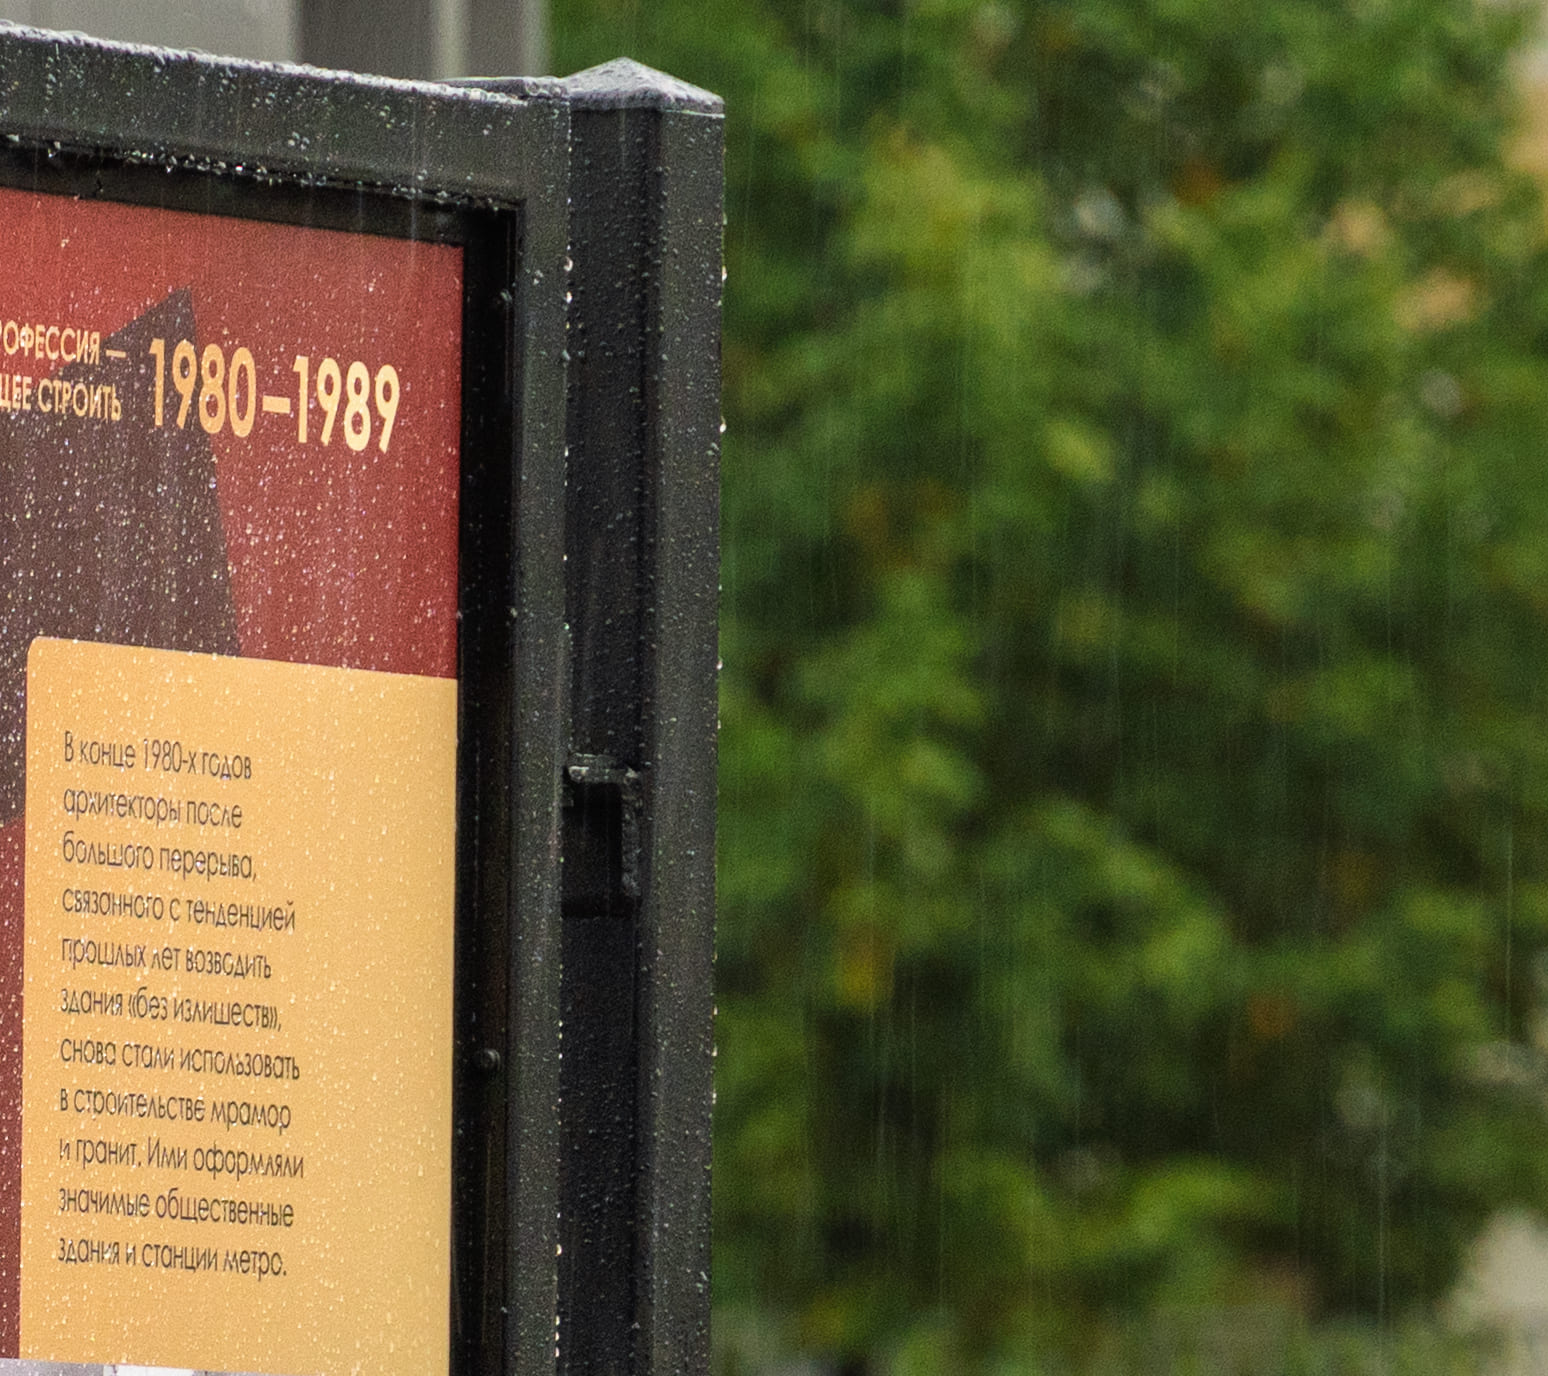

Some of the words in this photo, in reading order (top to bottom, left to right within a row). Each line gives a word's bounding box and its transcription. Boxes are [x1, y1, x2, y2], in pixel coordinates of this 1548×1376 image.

[38, 378, 122, 421] СТРОИТЬ
[149, 338, 400, 454] 1980–1989
[64, 730, 74, 762] В
[80, 740, 136, 768] конце
[144, 738, 197, 774] 1980-х
[202, 752, 252, 780] годов
[64, 788, 180, 826] архитекторы
[186, 800, 242, 828] после
[63, 830, 153, 870] большого
[160, 847, 256, 881] перерыва,
[62, 888, 163, 920] связанного
[170, 898, 180, 921] с
[186, 899, 294, 931] тенденцией
[62, 938, 146, 970] прошлых
[151, 946, 181, 970] лет
[186, 949, 272, 978] возводить
[61, 988, 122, 1016] здания
[129, 986, 168, 1020] «без
[174, 998, 282, 1034] излишеств»,
[60, 1038, 116, 1065] снова
[122, 1043, 174, 1070] стали
[180, 1048, 300, 1080] использовать
[60, 1088, 68, 1111] в
[74, 1089, 205, 1122] строительстве
[210, 1100, 291, 1135] мрамор
[60, 1138, 70, 1160] и
[77, 1139, 141, 1169] гранит.
[148, 1136, 188, 1170] Ими
[194, 1141, 304, 1180] оформляли
[59, 1188, 150, 1216] значимые
[156, 1187, 294, 1228] общественные
[58, 1238, 120, 1264] здания
[126, 1242, 136, 1264] и
[142, 1242, 217, 1272] станции
[223, 1250, 286, 1282] метро.
